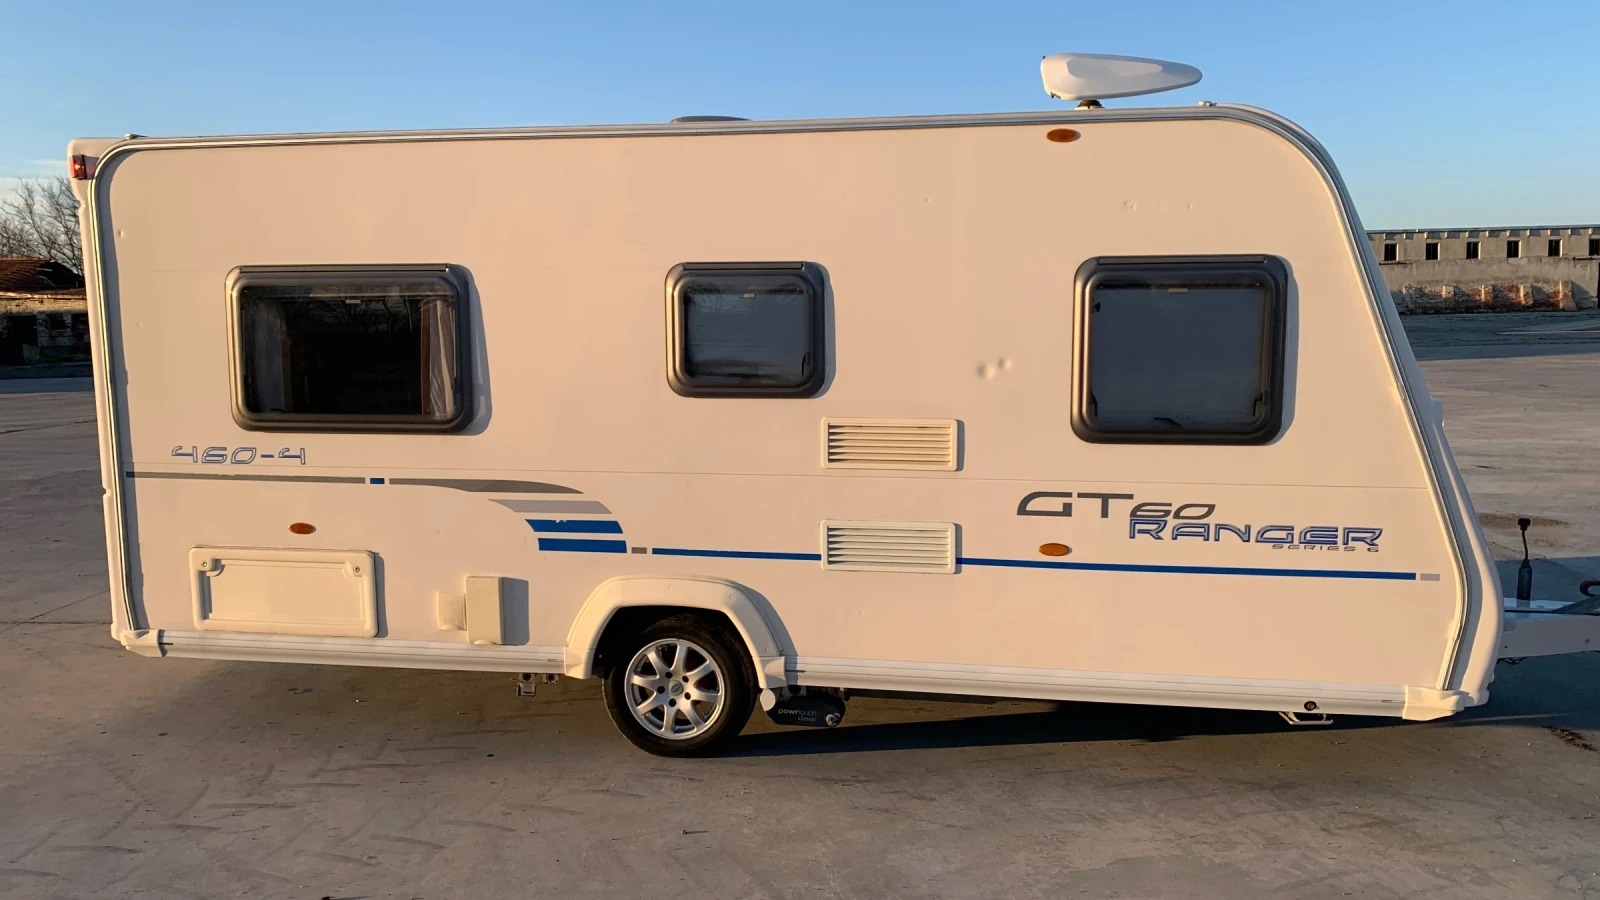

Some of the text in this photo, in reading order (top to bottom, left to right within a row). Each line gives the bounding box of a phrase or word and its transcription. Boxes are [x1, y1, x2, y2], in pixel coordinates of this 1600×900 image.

[171, 446, 306, 465] 460-4
[1129, 518, 1383, 547] RANGER
[1271, 543, 1356, 552] SERIES
